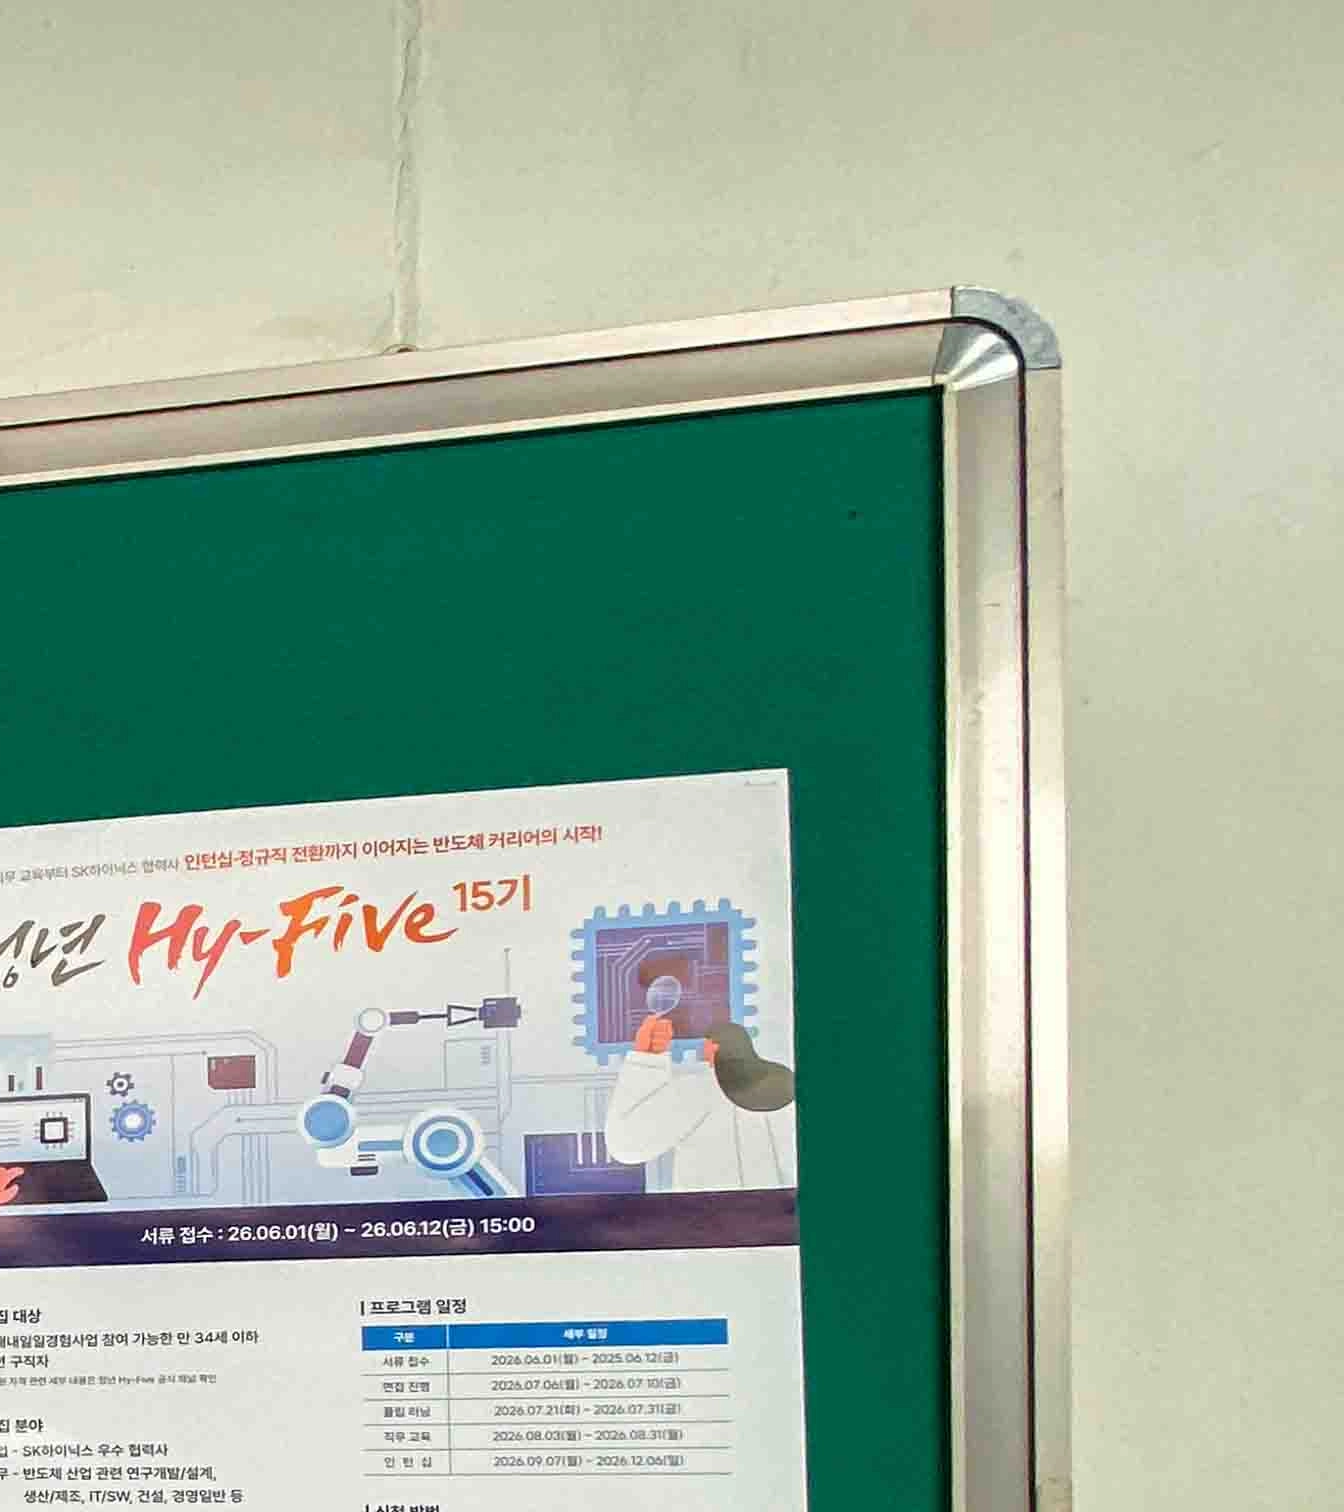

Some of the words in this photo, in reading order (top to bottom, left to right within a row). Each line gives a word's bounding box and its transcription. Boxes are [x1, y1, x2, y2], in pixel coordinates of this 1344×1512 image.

[292, 844, 357, 863] 전환까지
[362, 839, 429, 857] 이어지는
[433, 833, 484, 853] 반도체
[489, 829, 557, 848] 커리어의
[563, 825, 602, 843] 시작!
[128, 885, 459, 1000] Hy-Five
[452, 875, 530, 912] 15기
[141, 1228, 175, 1245] 서류
[180, 1227, 213, 1244] 접수
[228, 1224, 338, 1242] 26.06.01(월)
[361, 1219, 474, 1238] 26.06.12(금)
[480, 1217, 535, 1233] 15:00
[371, 1300, 431, 1315] 프로그램
[436, 1299, 466, 1314] 일정
[13, 1309, 40, 1323] 대상
[102, 1333, 128, 1346] 참여
[132, 1332, 172, 1346] 가능한
[177, 1332, 190, 1345] 만
[194, 1331, 227, 1344] 34세
[232, 1330, 259, 1344] 이하
[10, 1354, 48, 1368] 구직자
[16, 1419, 43, 1433] 분야
[23, 1444, 93, 1457] SK하이닉스
[98, 1444, 124, 1456] 우수
[129, 1444, 168, 1456] 협력사
